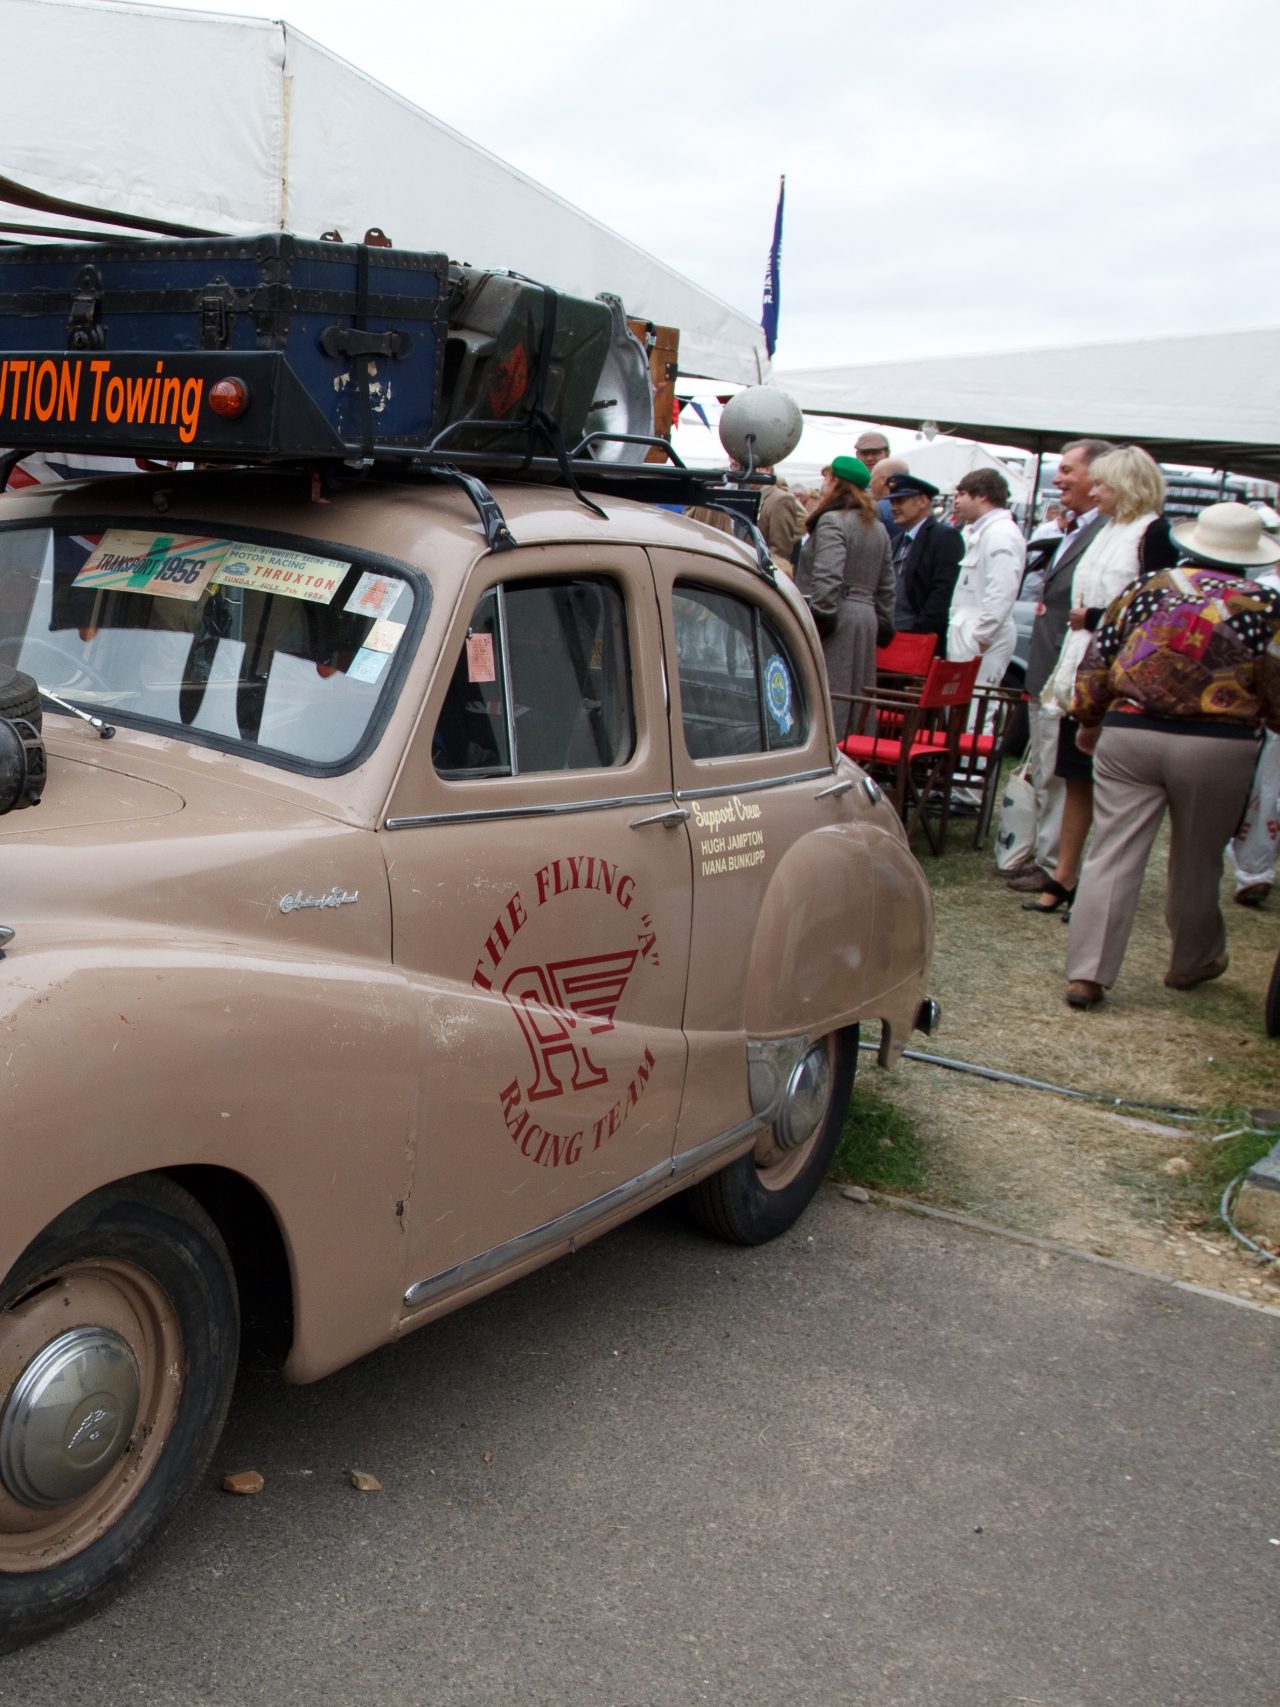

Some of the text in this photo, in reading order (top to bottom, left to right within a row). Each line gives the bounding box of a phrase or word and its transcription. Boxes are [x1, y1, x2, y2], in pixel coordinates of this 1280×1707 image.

[89, 360, 204, 444] Towing
[96, 553, 207, 585] TRANSPORT 1956
[229, 550, 307, 570] MOTOR RACING
[223, 575, 257, 586] SUNDAY
[259, 582, 280, 591] JULY
[253, 565, 336, 591] THRUXTON
[691, 795, 762, 833] Support Crew
[701, 830, 764, 856] HUGH JAMPTON
[702, 849, 766, 877] IVANA BUNKUPP
[471, 890, 528, 994] THE
[534, 856, 636, 910] FLYING
[499, 1043, 656, 1168] RACING TEAM
